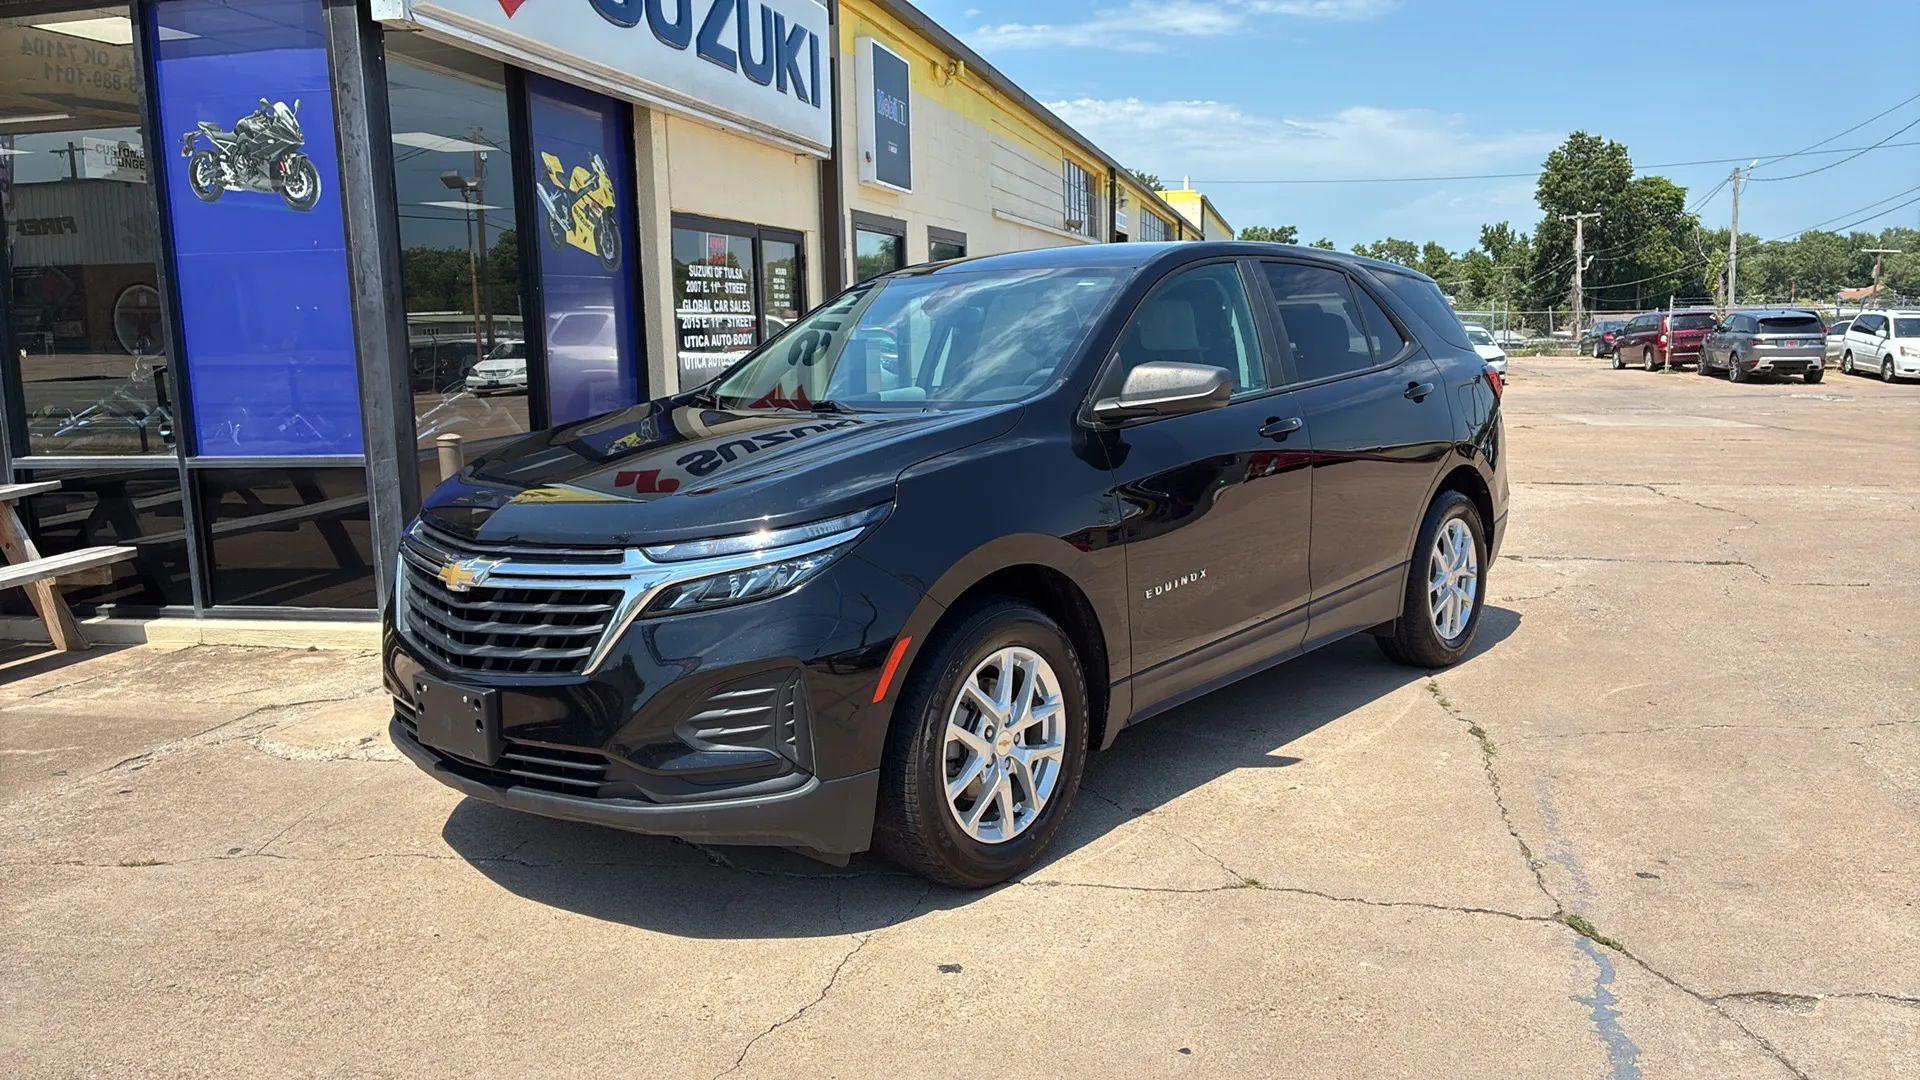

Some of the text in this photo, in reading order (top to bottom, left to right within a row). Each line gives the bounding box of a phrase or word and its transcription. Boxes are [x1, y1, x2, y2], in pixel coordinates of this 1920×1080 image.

[104, 155, 145, 170] LOUNGE
[688, 264, 744, 280] SUZUKI OF TULSA
[685, 280, 701, 293] 2007
[724, 282, 747, 294] STREET
[682, 299, 751, 313] GLOBAL CAR SALES
[682, 317, 701, 329] 2015
[727, 317, 752, 328] STREET
[684, 333, 752, 349] UTICA AUTO BODY
[684, 356, 707, 370] UTICA
[1145, 568, 1207, 599] EQUINOX
